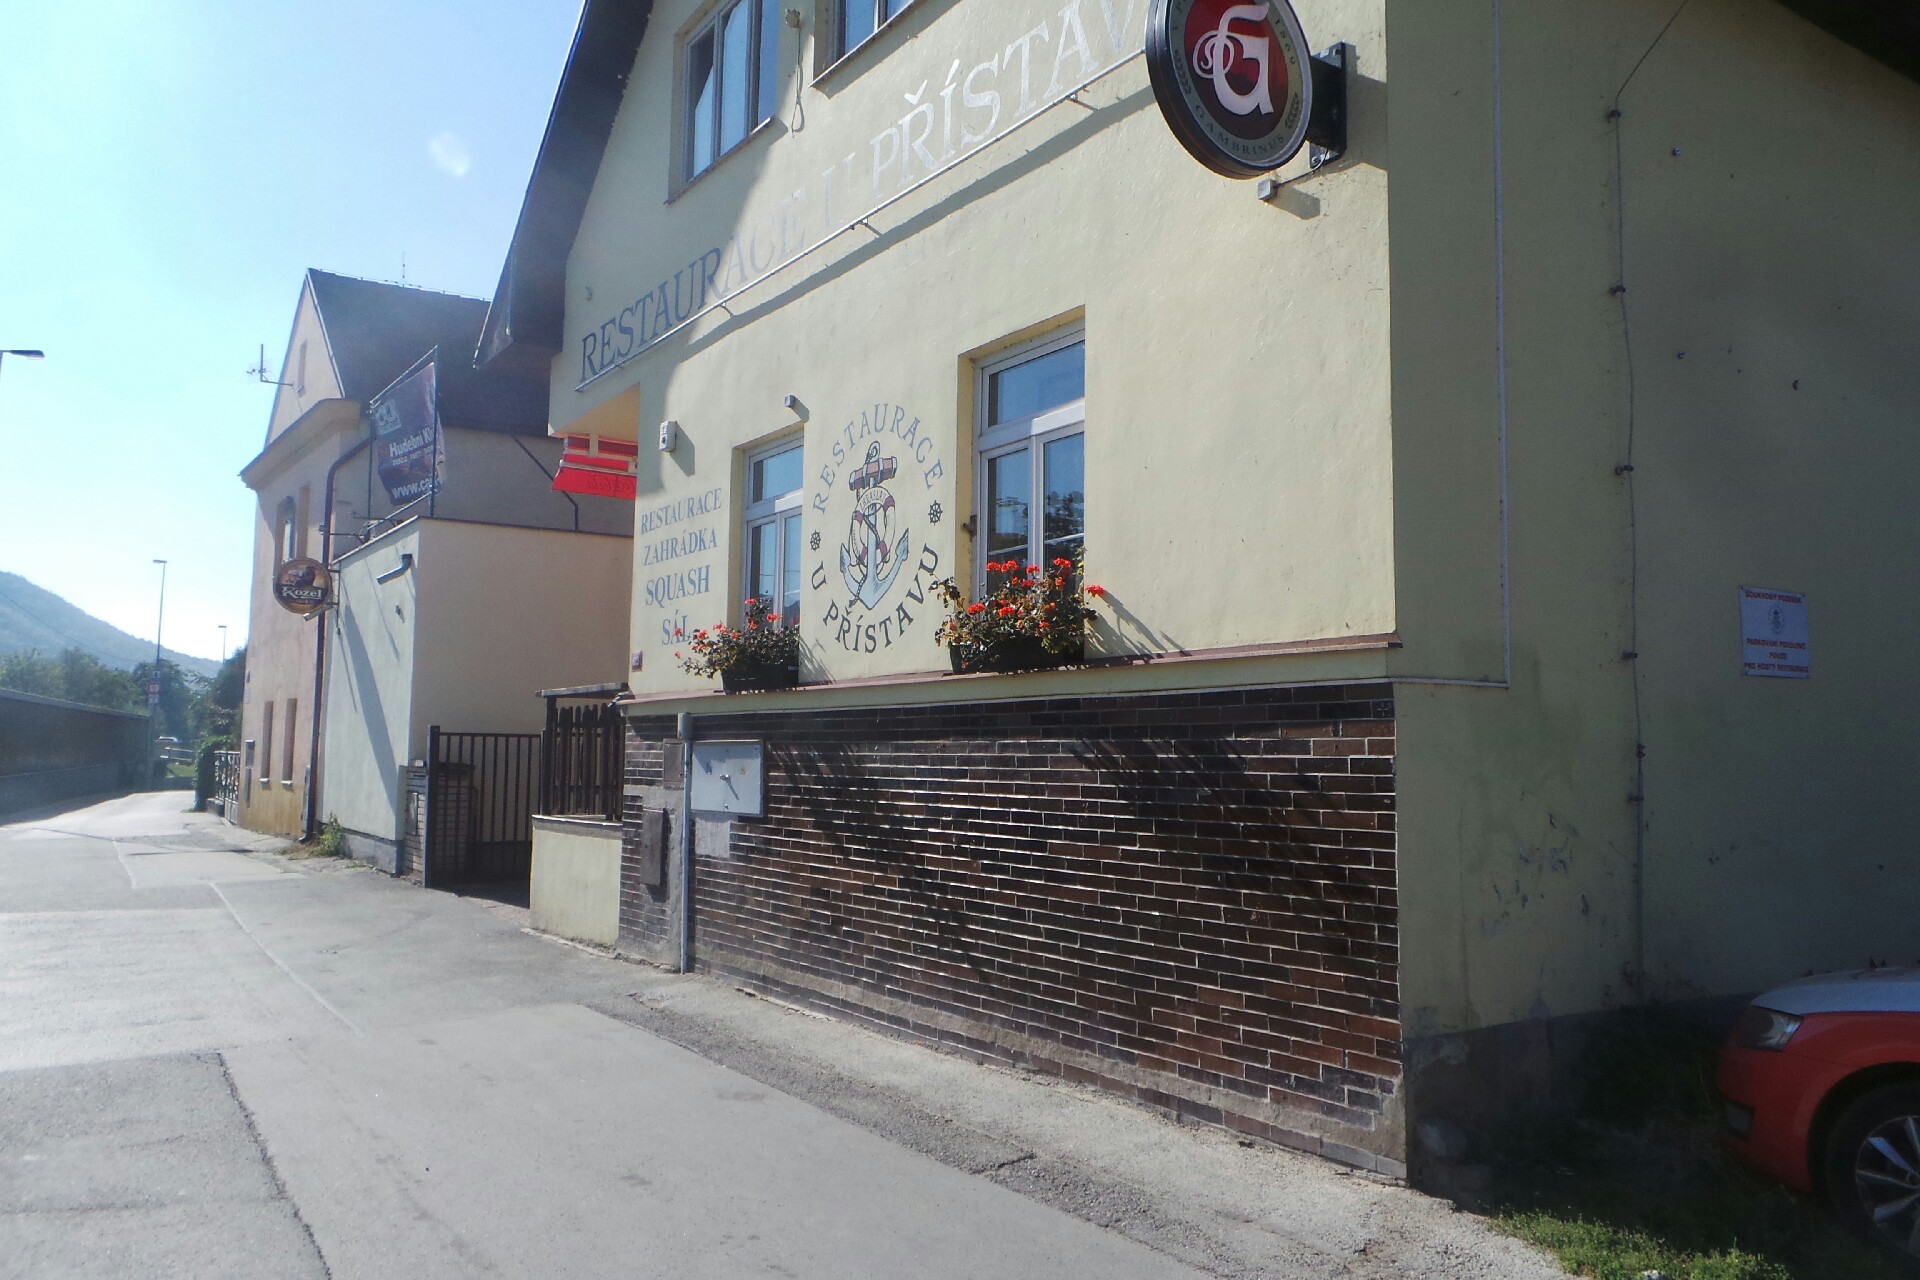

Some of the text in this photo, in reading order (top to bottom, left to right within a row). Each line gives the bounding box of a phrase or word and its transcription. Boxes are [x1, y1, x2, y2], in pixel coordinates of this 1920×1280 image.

[1195, 105, 1285, 156] GAMBRINUS
[580, 185, 806, 383] RESTAURACE
[822, 152, 856, 229] U
[812, 403, 945, 514] RESTAURACE
[641, 488, 722, 535] RESTAURACE
[643, 527, 718, 567] ZAHRÁDKA
[281, 586, 322, 599] Kozel
[645, 565, 711, 608] SQUASH
[811, 543, 939, 654] U PŘÍSTAVU
[662, 610, 691, 646] SÁL
